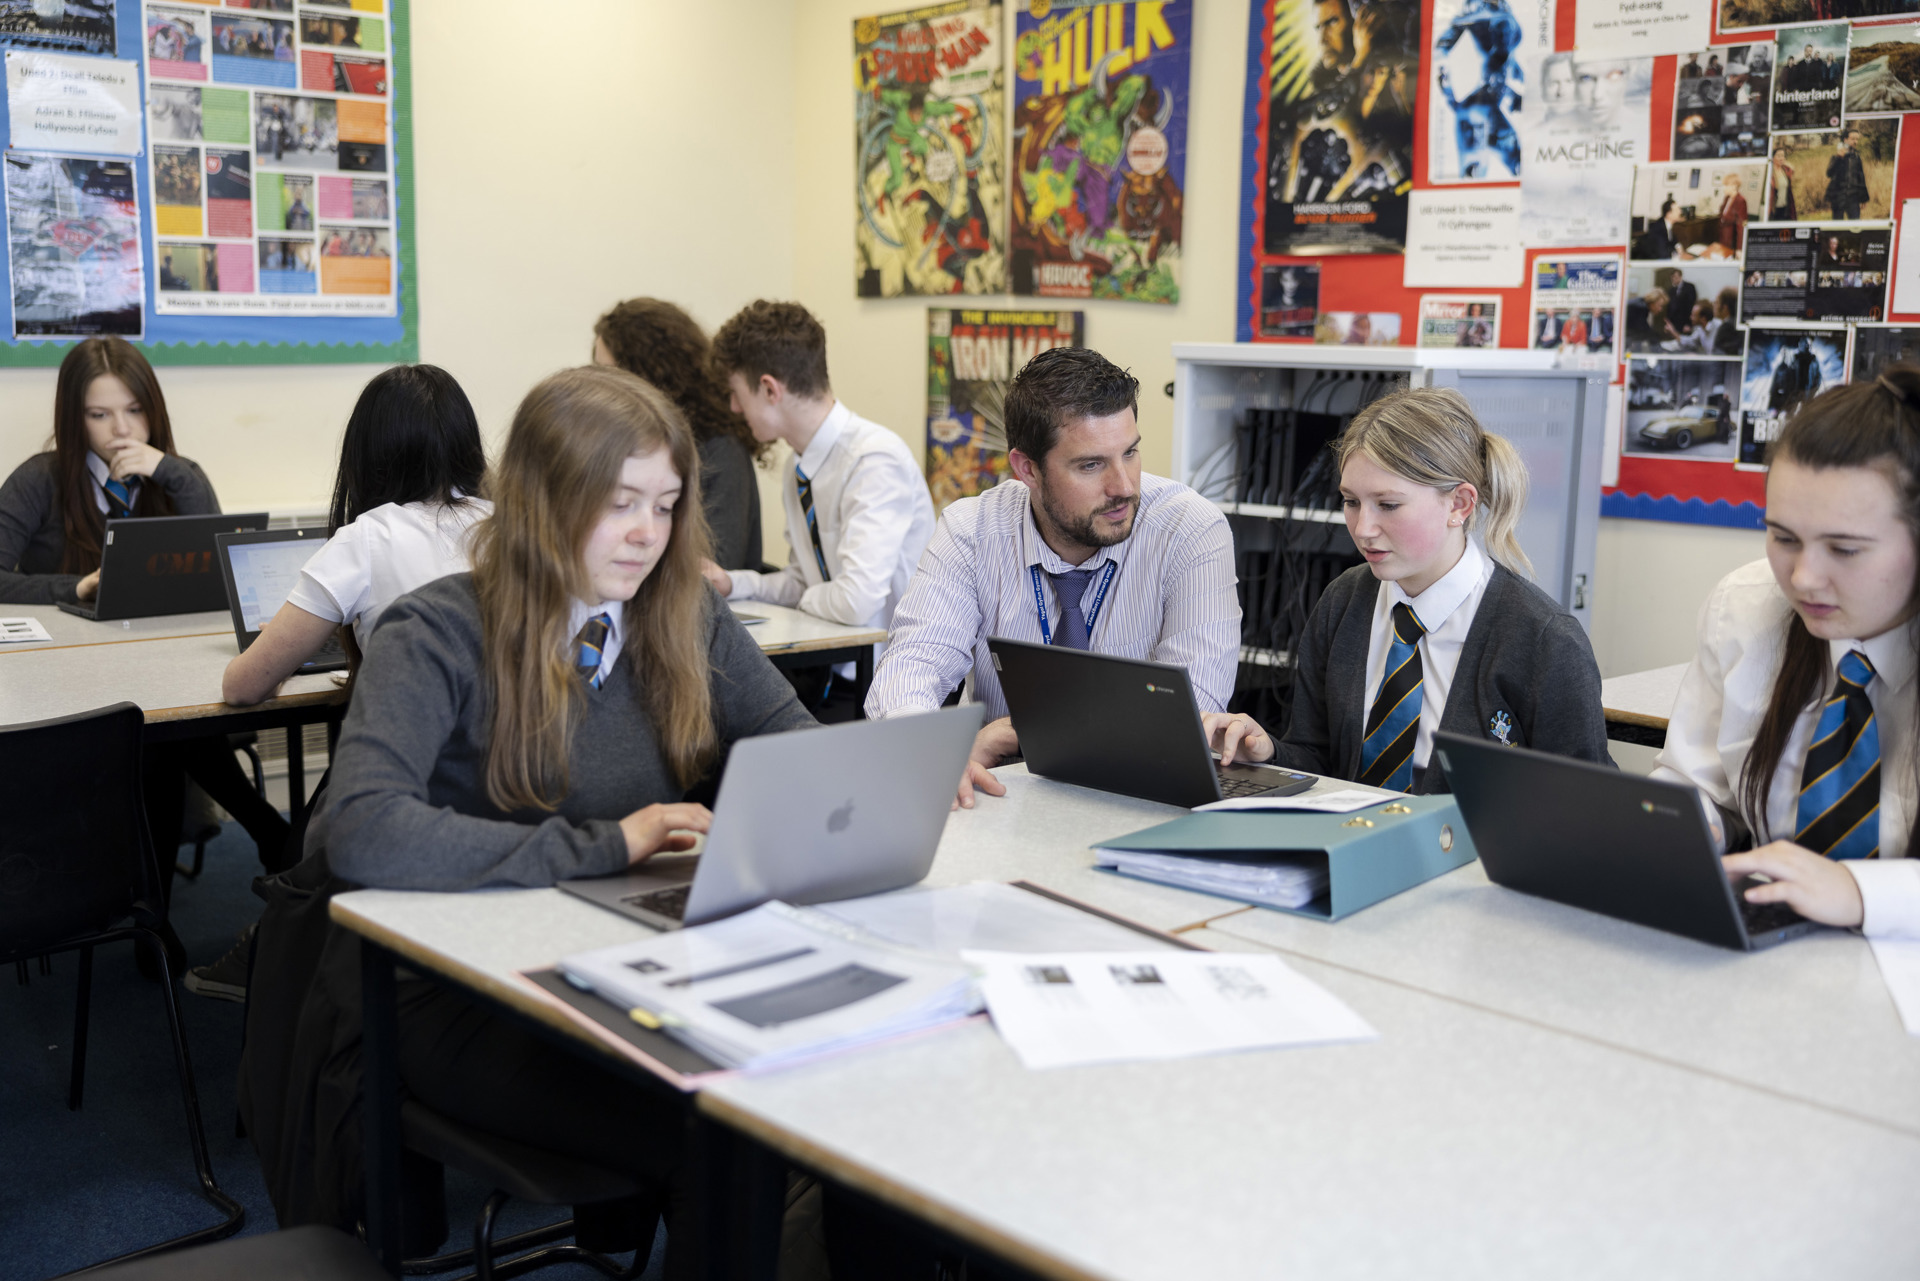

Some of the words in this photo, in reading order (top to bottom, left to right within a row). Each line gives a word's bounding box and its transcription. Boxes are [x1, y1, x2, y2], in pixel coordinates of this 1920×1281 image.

[1042, 0, 1176, 95] HULK
[1775, 87, 1840, 103] hinterland
[35, 121, 85, 135] Hollywood
[1536, 140, 1634, 162] MACHINE
[1293, 202, 1340, 215] HARRISON
[1342, 202, 1372, 214] FORD
[1041, 263, 1091, 287] HAVOC
[1577, 270, 1599, 281] The
[1567, 277, 1616, 290] Guardian
[961, 311, 985, 324] THE
[988, 312, 1056, 325] INVINCIBLE
[1424, 303, 1465, 319] Mirror
[951, 325, 1009, 380] IRON
[1097, 578, 1109, 599] Gymraeg
